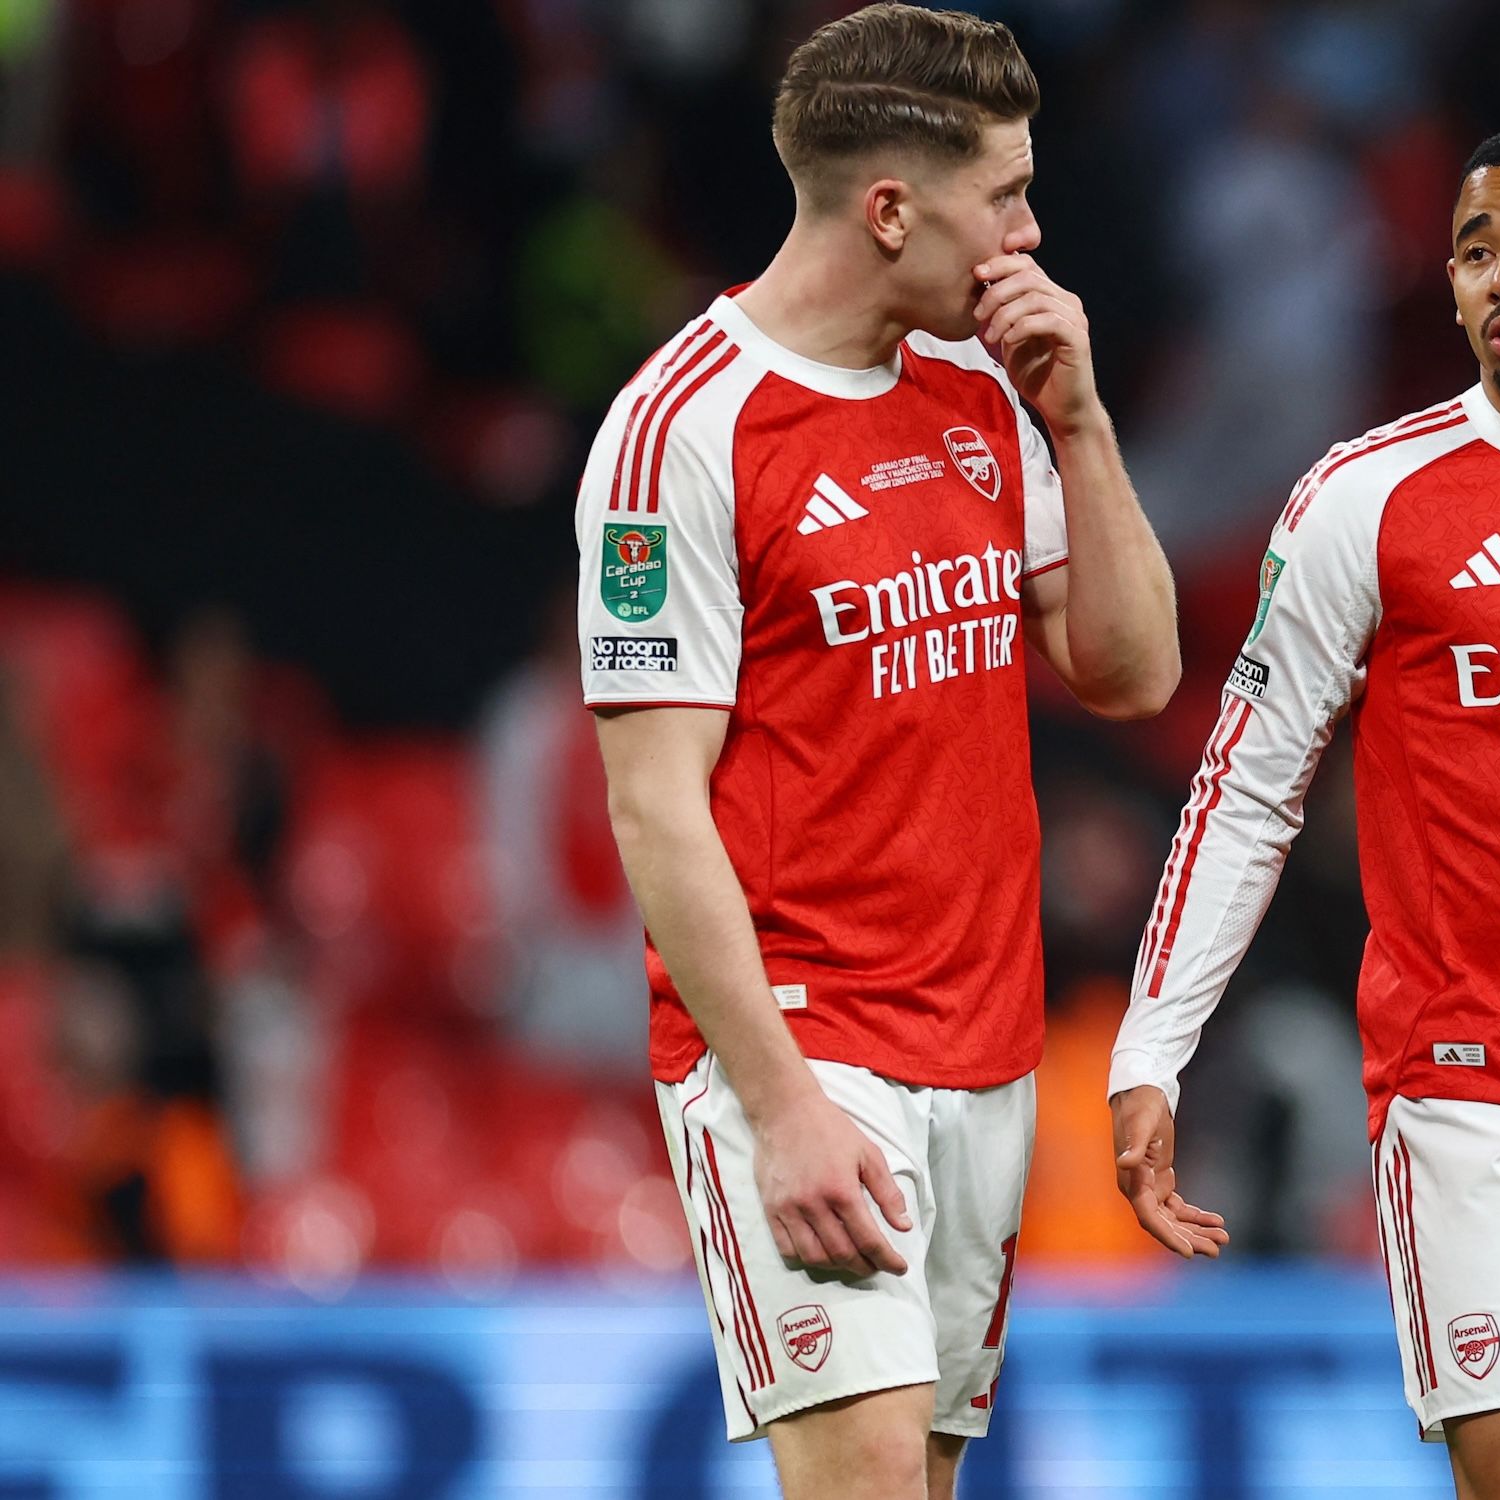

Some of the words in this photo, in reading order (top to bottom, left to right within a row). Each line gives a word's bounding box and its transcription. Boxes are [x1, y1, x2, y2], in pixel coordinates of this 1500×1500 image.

[952, 440, 985, 453] Arsenal
[898, 458, 910, 469] CUP
[911, 454, 929, 466] FINAL
[861, 472, 889, 486] ARSENAL
[893, 463, 932, 478] MANCHESTER
[932, 460, 946, 470] CITY
[905, 472, 929, 484] MARCH
[605, 560, 662, 577] Carabao
[620, 575, 646, 588] Cup
[810, 540, 1022, 647] Emirate
[632, 606, 649, 615] EFL
[591, 638, 614, 655] No
[617, 640, 668, 656] room
[615, 655, 677, 671] racism
[872, 635, 917, 699] FLY
[925, 614, 1018, 684] BETTER
[783, 1314, 821, 1334] Arsenal
[1454, 1322, 1490, 1339] Arsenal
